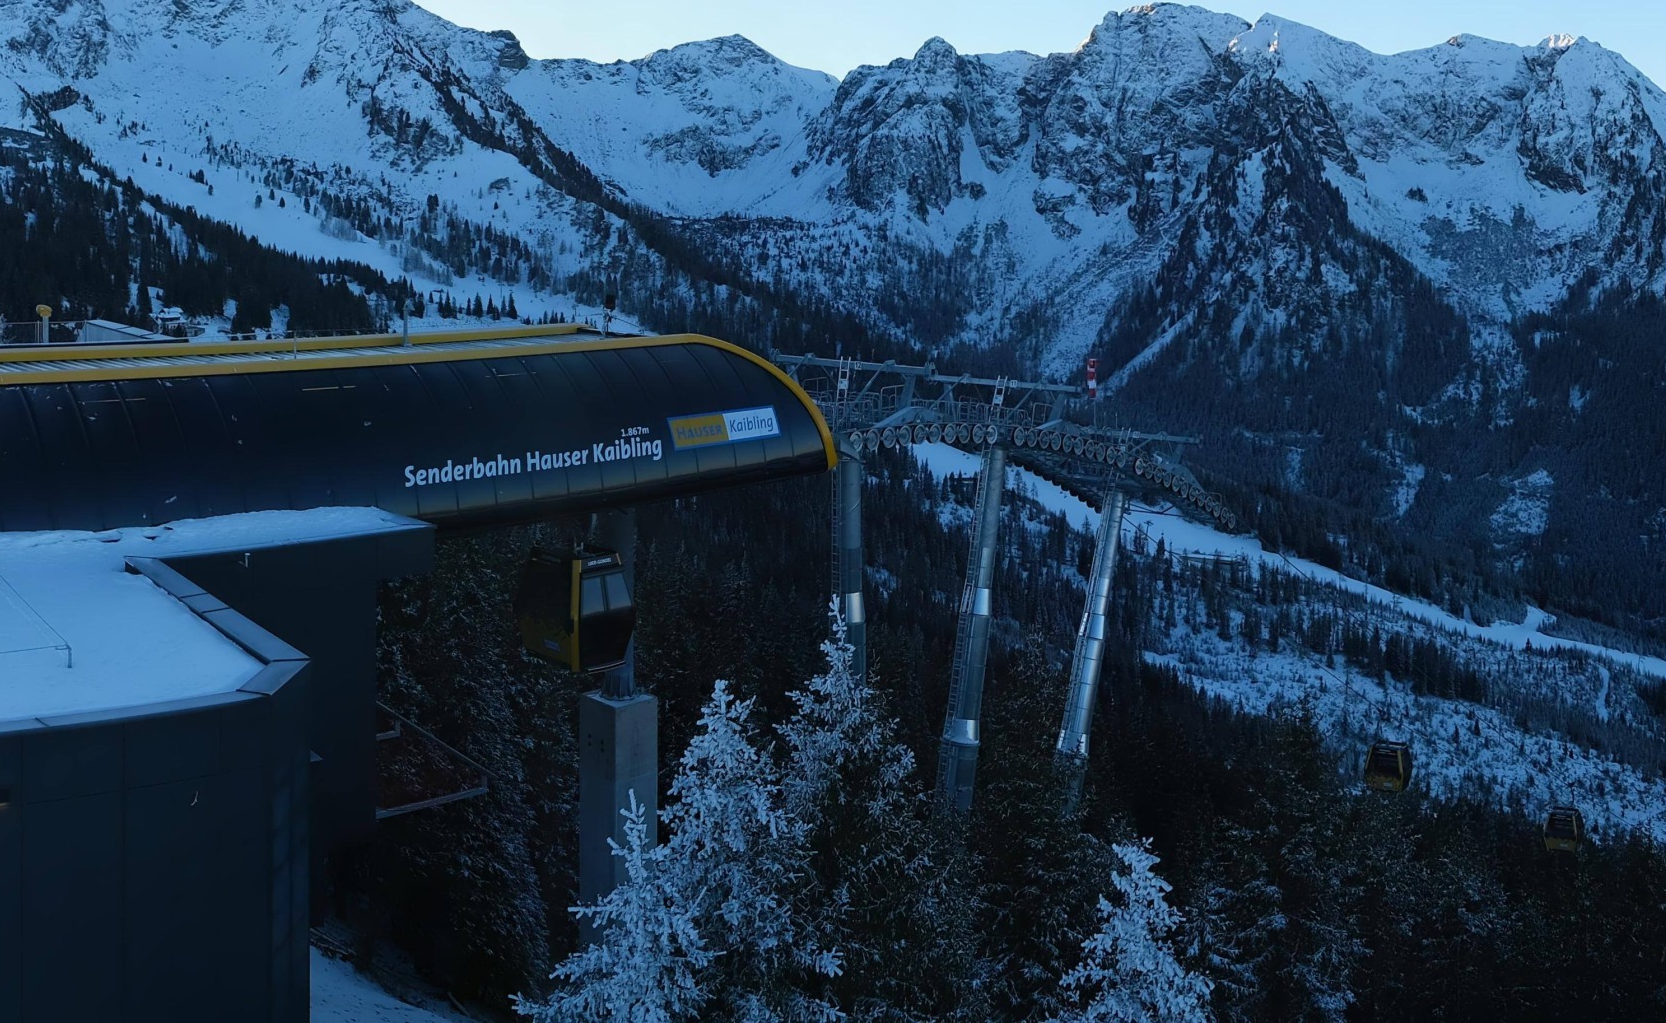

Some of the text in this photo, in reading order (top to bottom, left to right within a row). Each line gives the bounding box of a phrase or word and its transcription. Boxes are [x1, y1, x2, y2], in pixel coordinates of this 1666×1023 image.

[620, 426, 650, 438] 1.867m
[676, 416, 774, 440] HAUSER Kaibling
[404, 436, 662, 489] Senderbahn Hauser Kaibling
